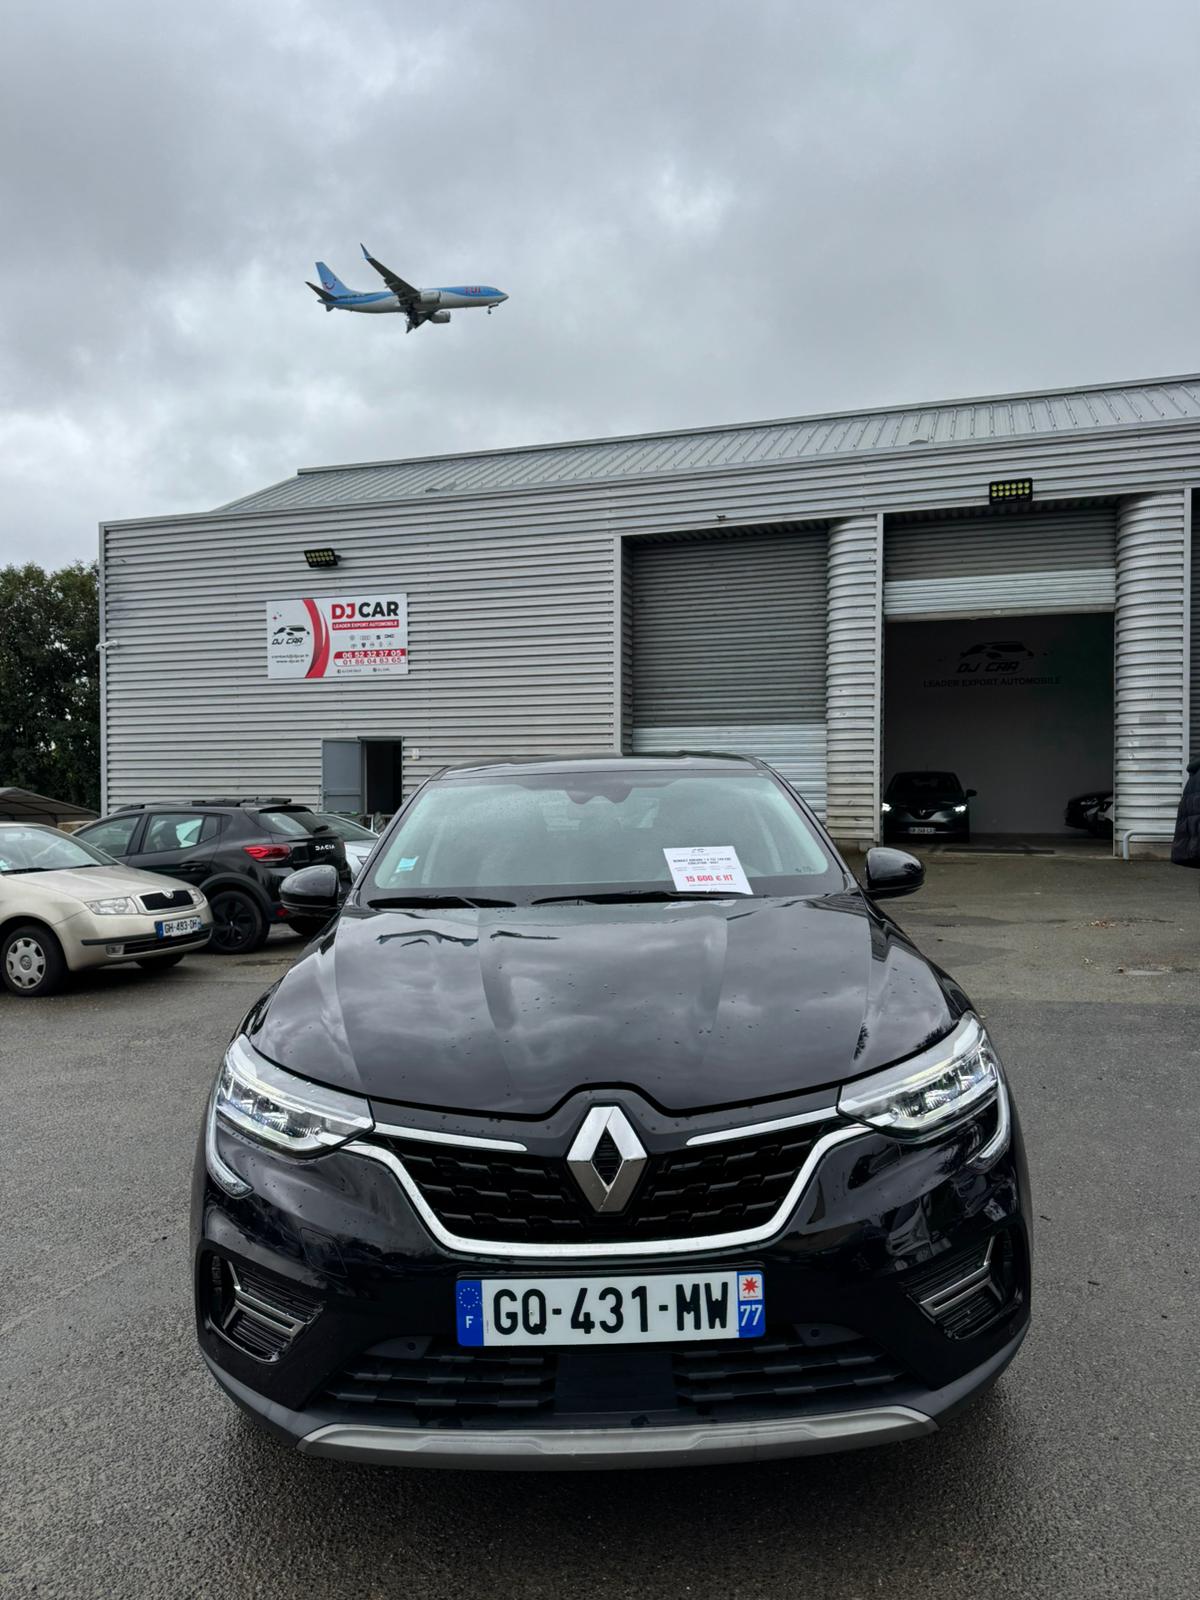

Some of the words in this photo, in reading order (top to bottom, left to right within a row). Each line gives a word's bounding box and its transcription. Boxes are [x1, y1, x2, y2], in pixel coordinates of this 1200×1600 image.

[331, 602, 356, 620] DJ
[358, 601, 399, 618] CAR
[286, 637, 303, 645] CAR
[956, 662, 982, 673] DJ
[984, 661, 1019, 672] CAR
[923, 679, 959, 688] LEADER
[962, 678, 998, 687] EXPORT
[1000, 676, 1062, 686] AUTOMOBILE
[493, 1282, 728, 1335] GQ-431-MW
[740, 1304, 763, 1327] 77
[465, 1315, 474, 1329] F
